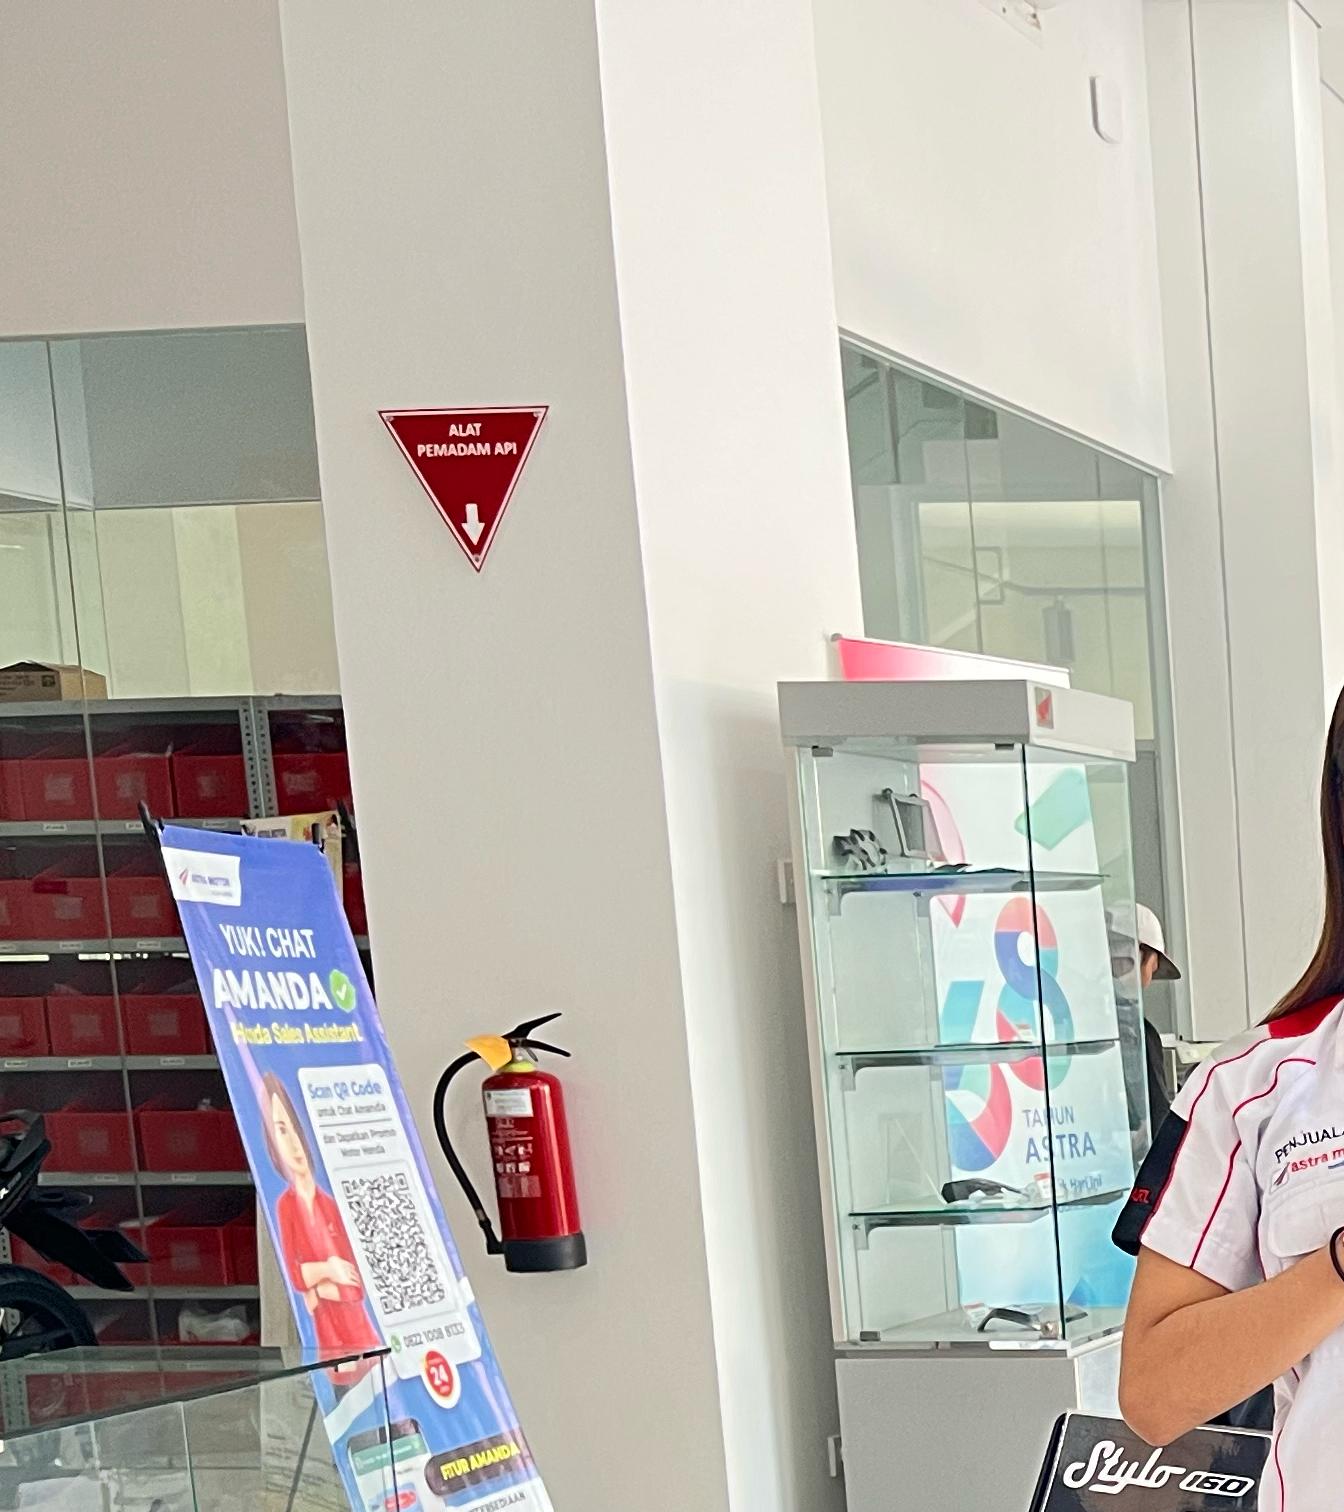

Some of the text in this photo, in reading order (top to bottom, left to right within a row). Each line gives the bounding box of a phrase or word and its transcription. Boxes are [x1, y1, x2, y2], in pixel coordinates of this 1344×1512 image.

[448, 423, 482, 437] ALAT
[417, 442, 517, 458] PEMADAM API
[219, 923, 317, 958] YUK! CHAT
[212, 968, 333, 1010] AMANDA
[232, 1020, 305, 1044] Honda Sales
[307, 1079, 382, 1101] Scan QR Code
[1290, 1150, 1330, 1174] astra
[429, 1364, 449, 1386] 24
[440, 1442, 520, 1481] FITUR AMANDA
[1063, 1440, 1253, 1496] Stylo 160
